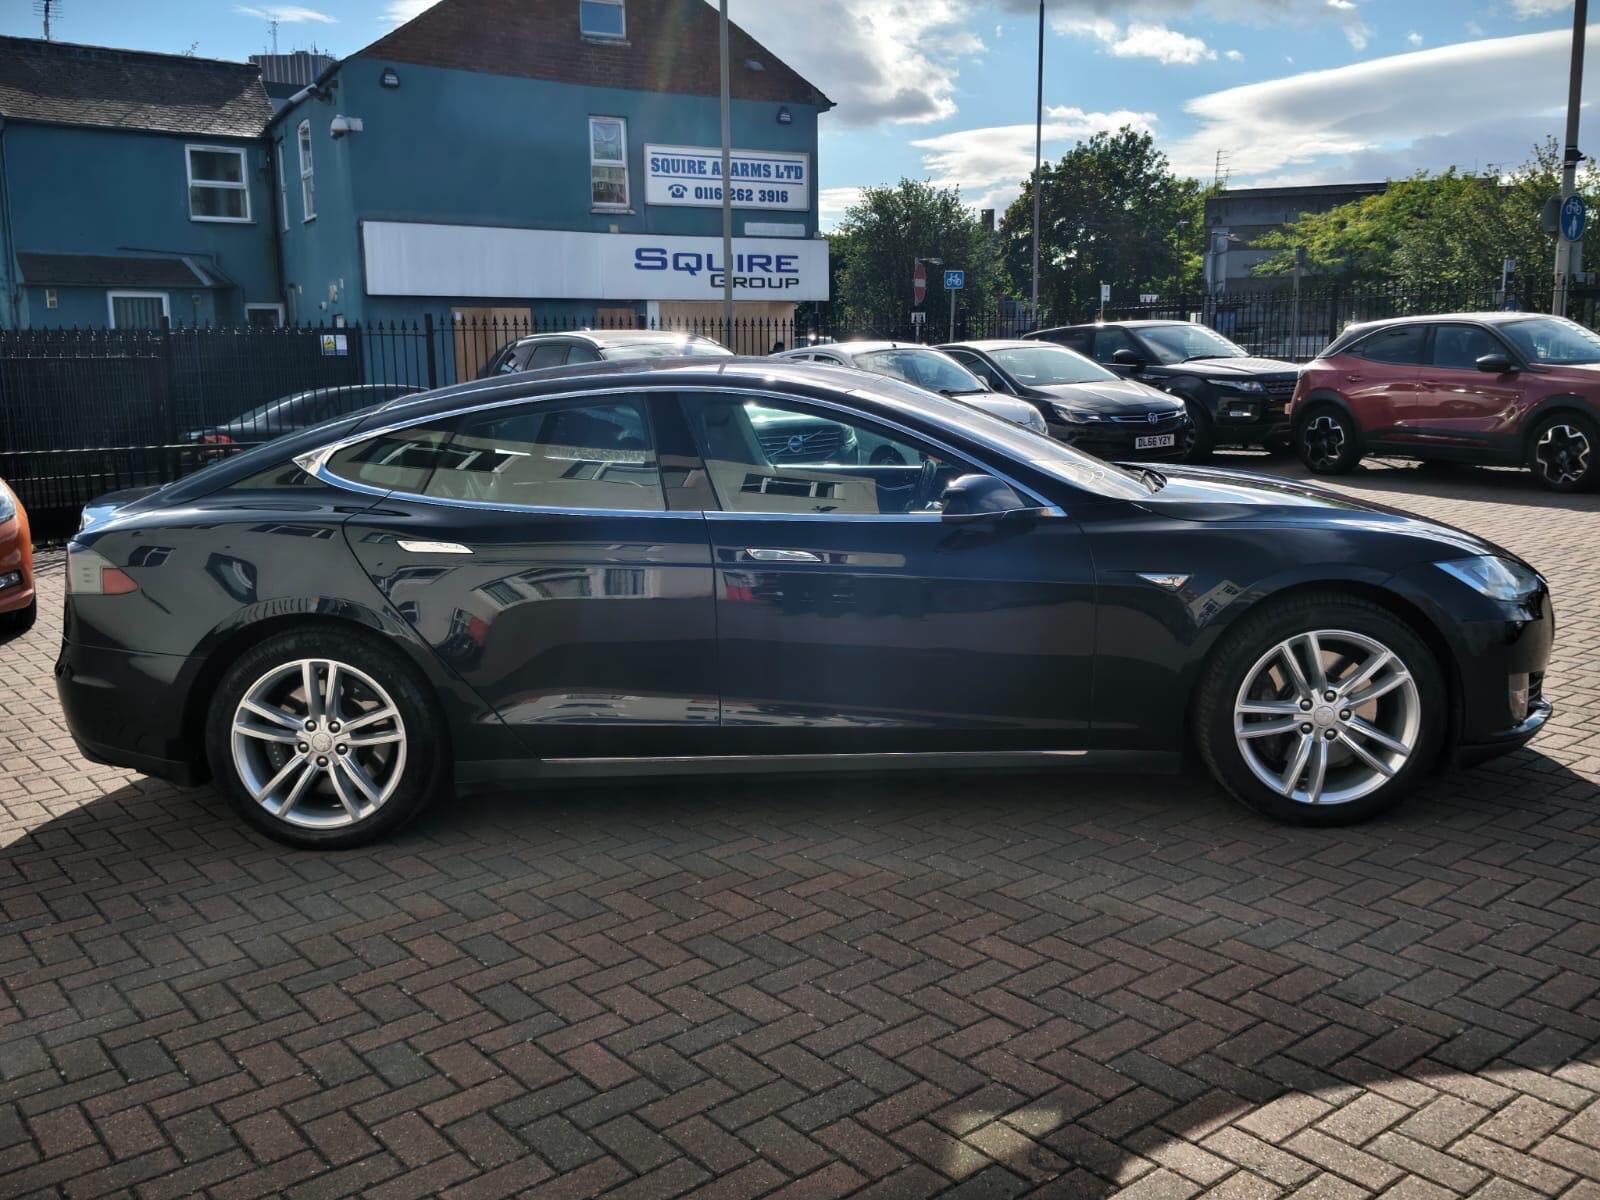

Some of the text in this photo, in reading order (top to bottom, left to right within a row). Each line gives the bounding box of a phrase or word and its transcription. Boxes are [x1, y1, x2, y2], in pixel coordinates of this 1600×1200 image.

[651, 158, 803, 180] SQUIRE AARMS LTD
[695, 187, 788, 203] 0116 262 3916
[634, 248, 799, 276] SQUIRE
[1138, 436, 1171, 447] DL66 YZY
